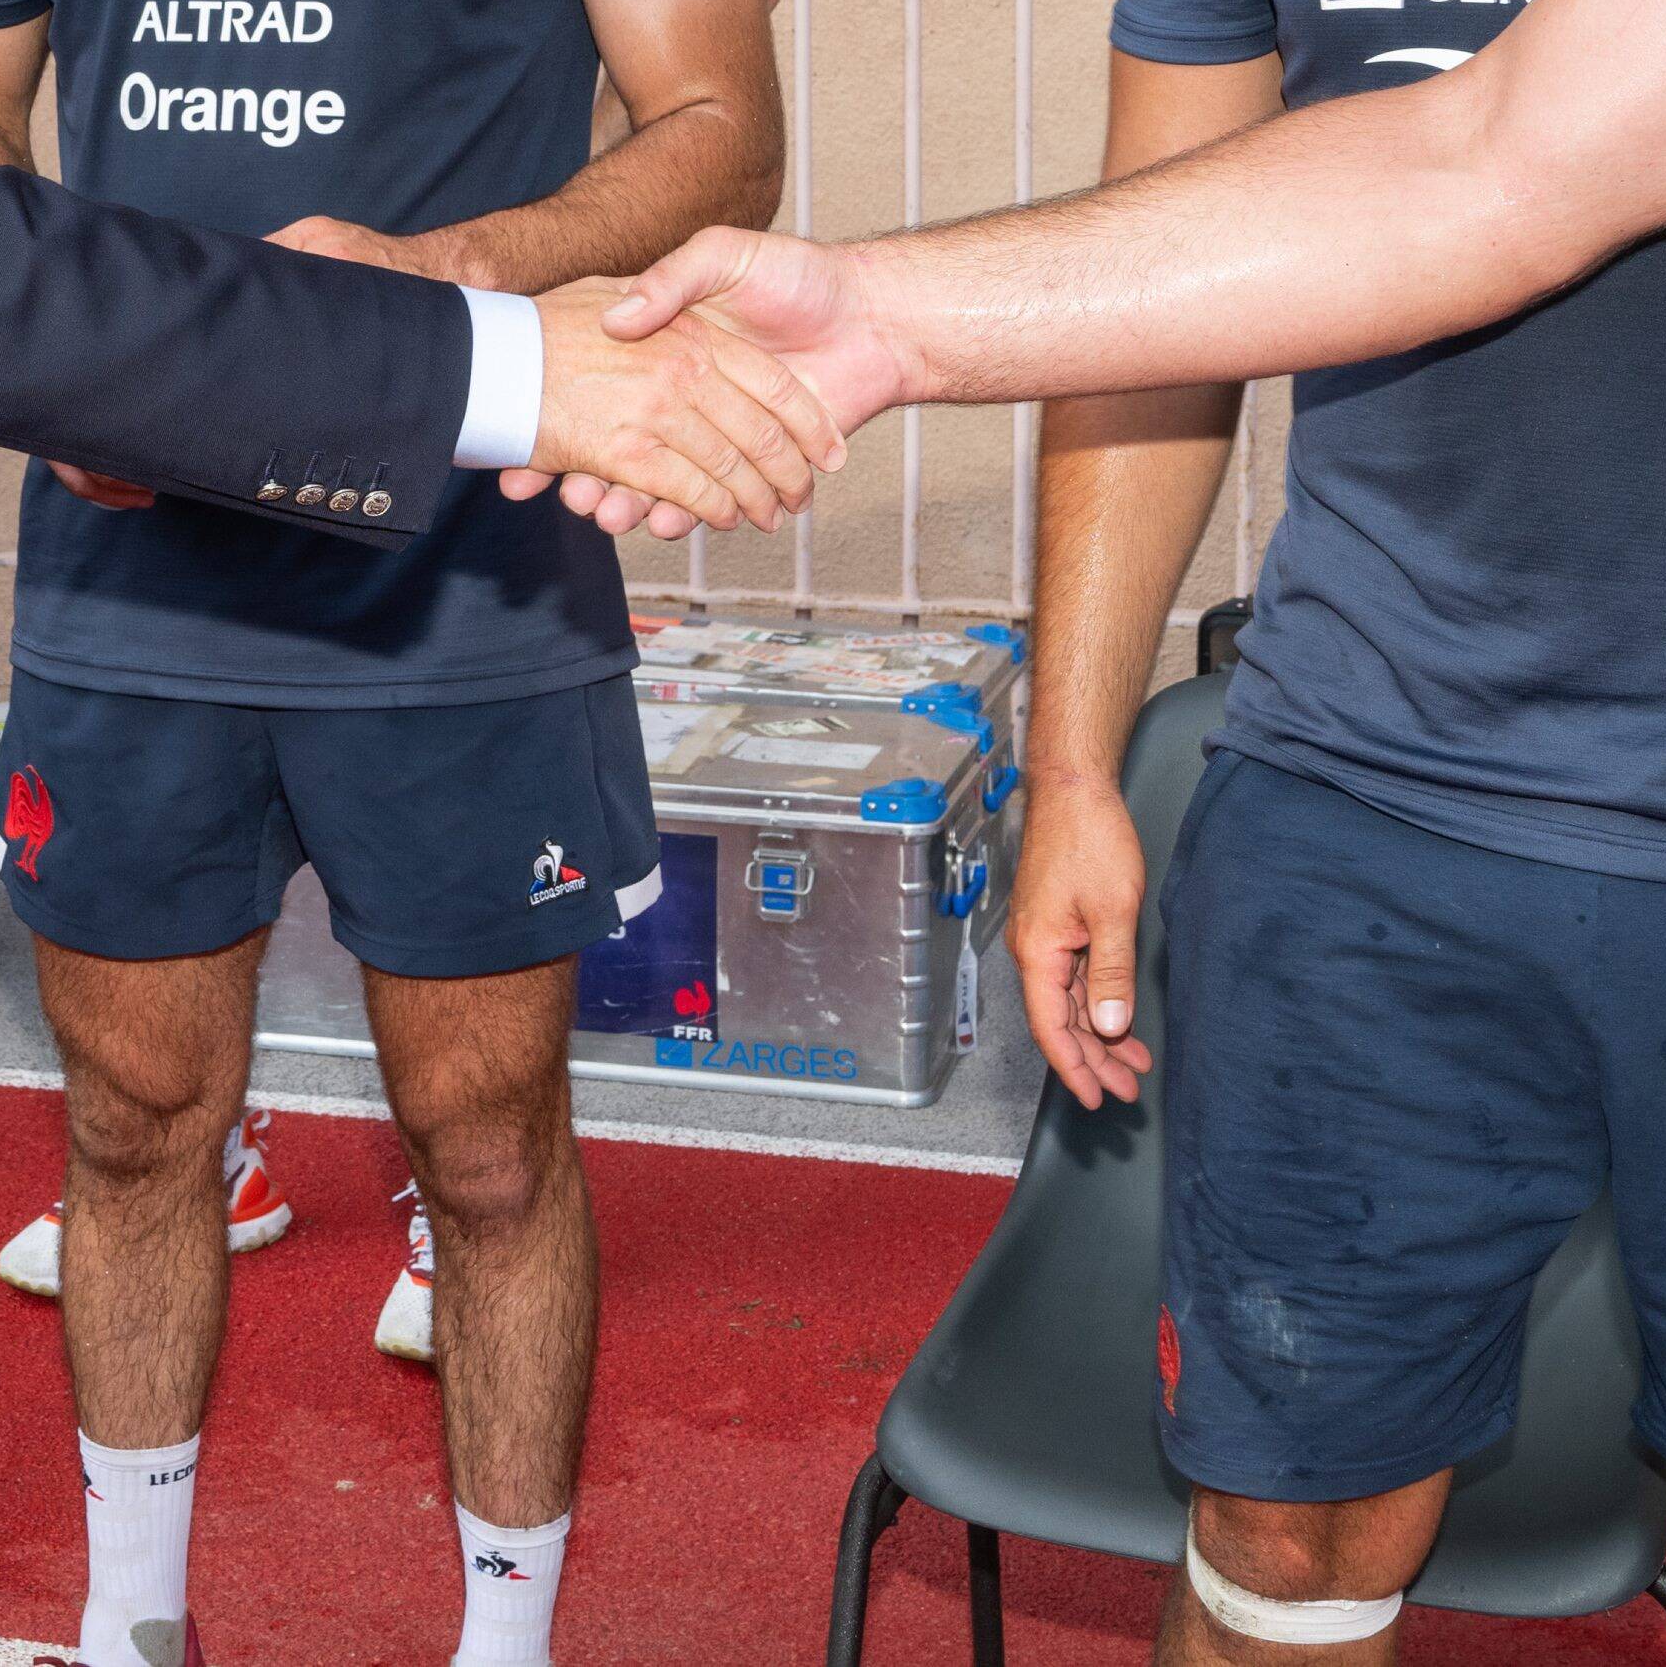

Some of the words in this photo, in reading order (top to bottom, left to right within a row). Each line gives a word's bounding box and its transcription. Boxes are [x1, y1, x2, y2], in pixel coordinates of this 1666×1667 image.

[133, 0, 333, 43] ALTRAD
[120, 71, 346, 148] Orange
[529, 892, 540, 905] LE
[555, 876, 586, 896] SPORTIF
[673, 1024, 713, 1042] FFR
[701, 1038, 858, 1080] ZARGES
[150, 1472, 169, 1486] LE
[173, 1463, 197, 1482] CO
